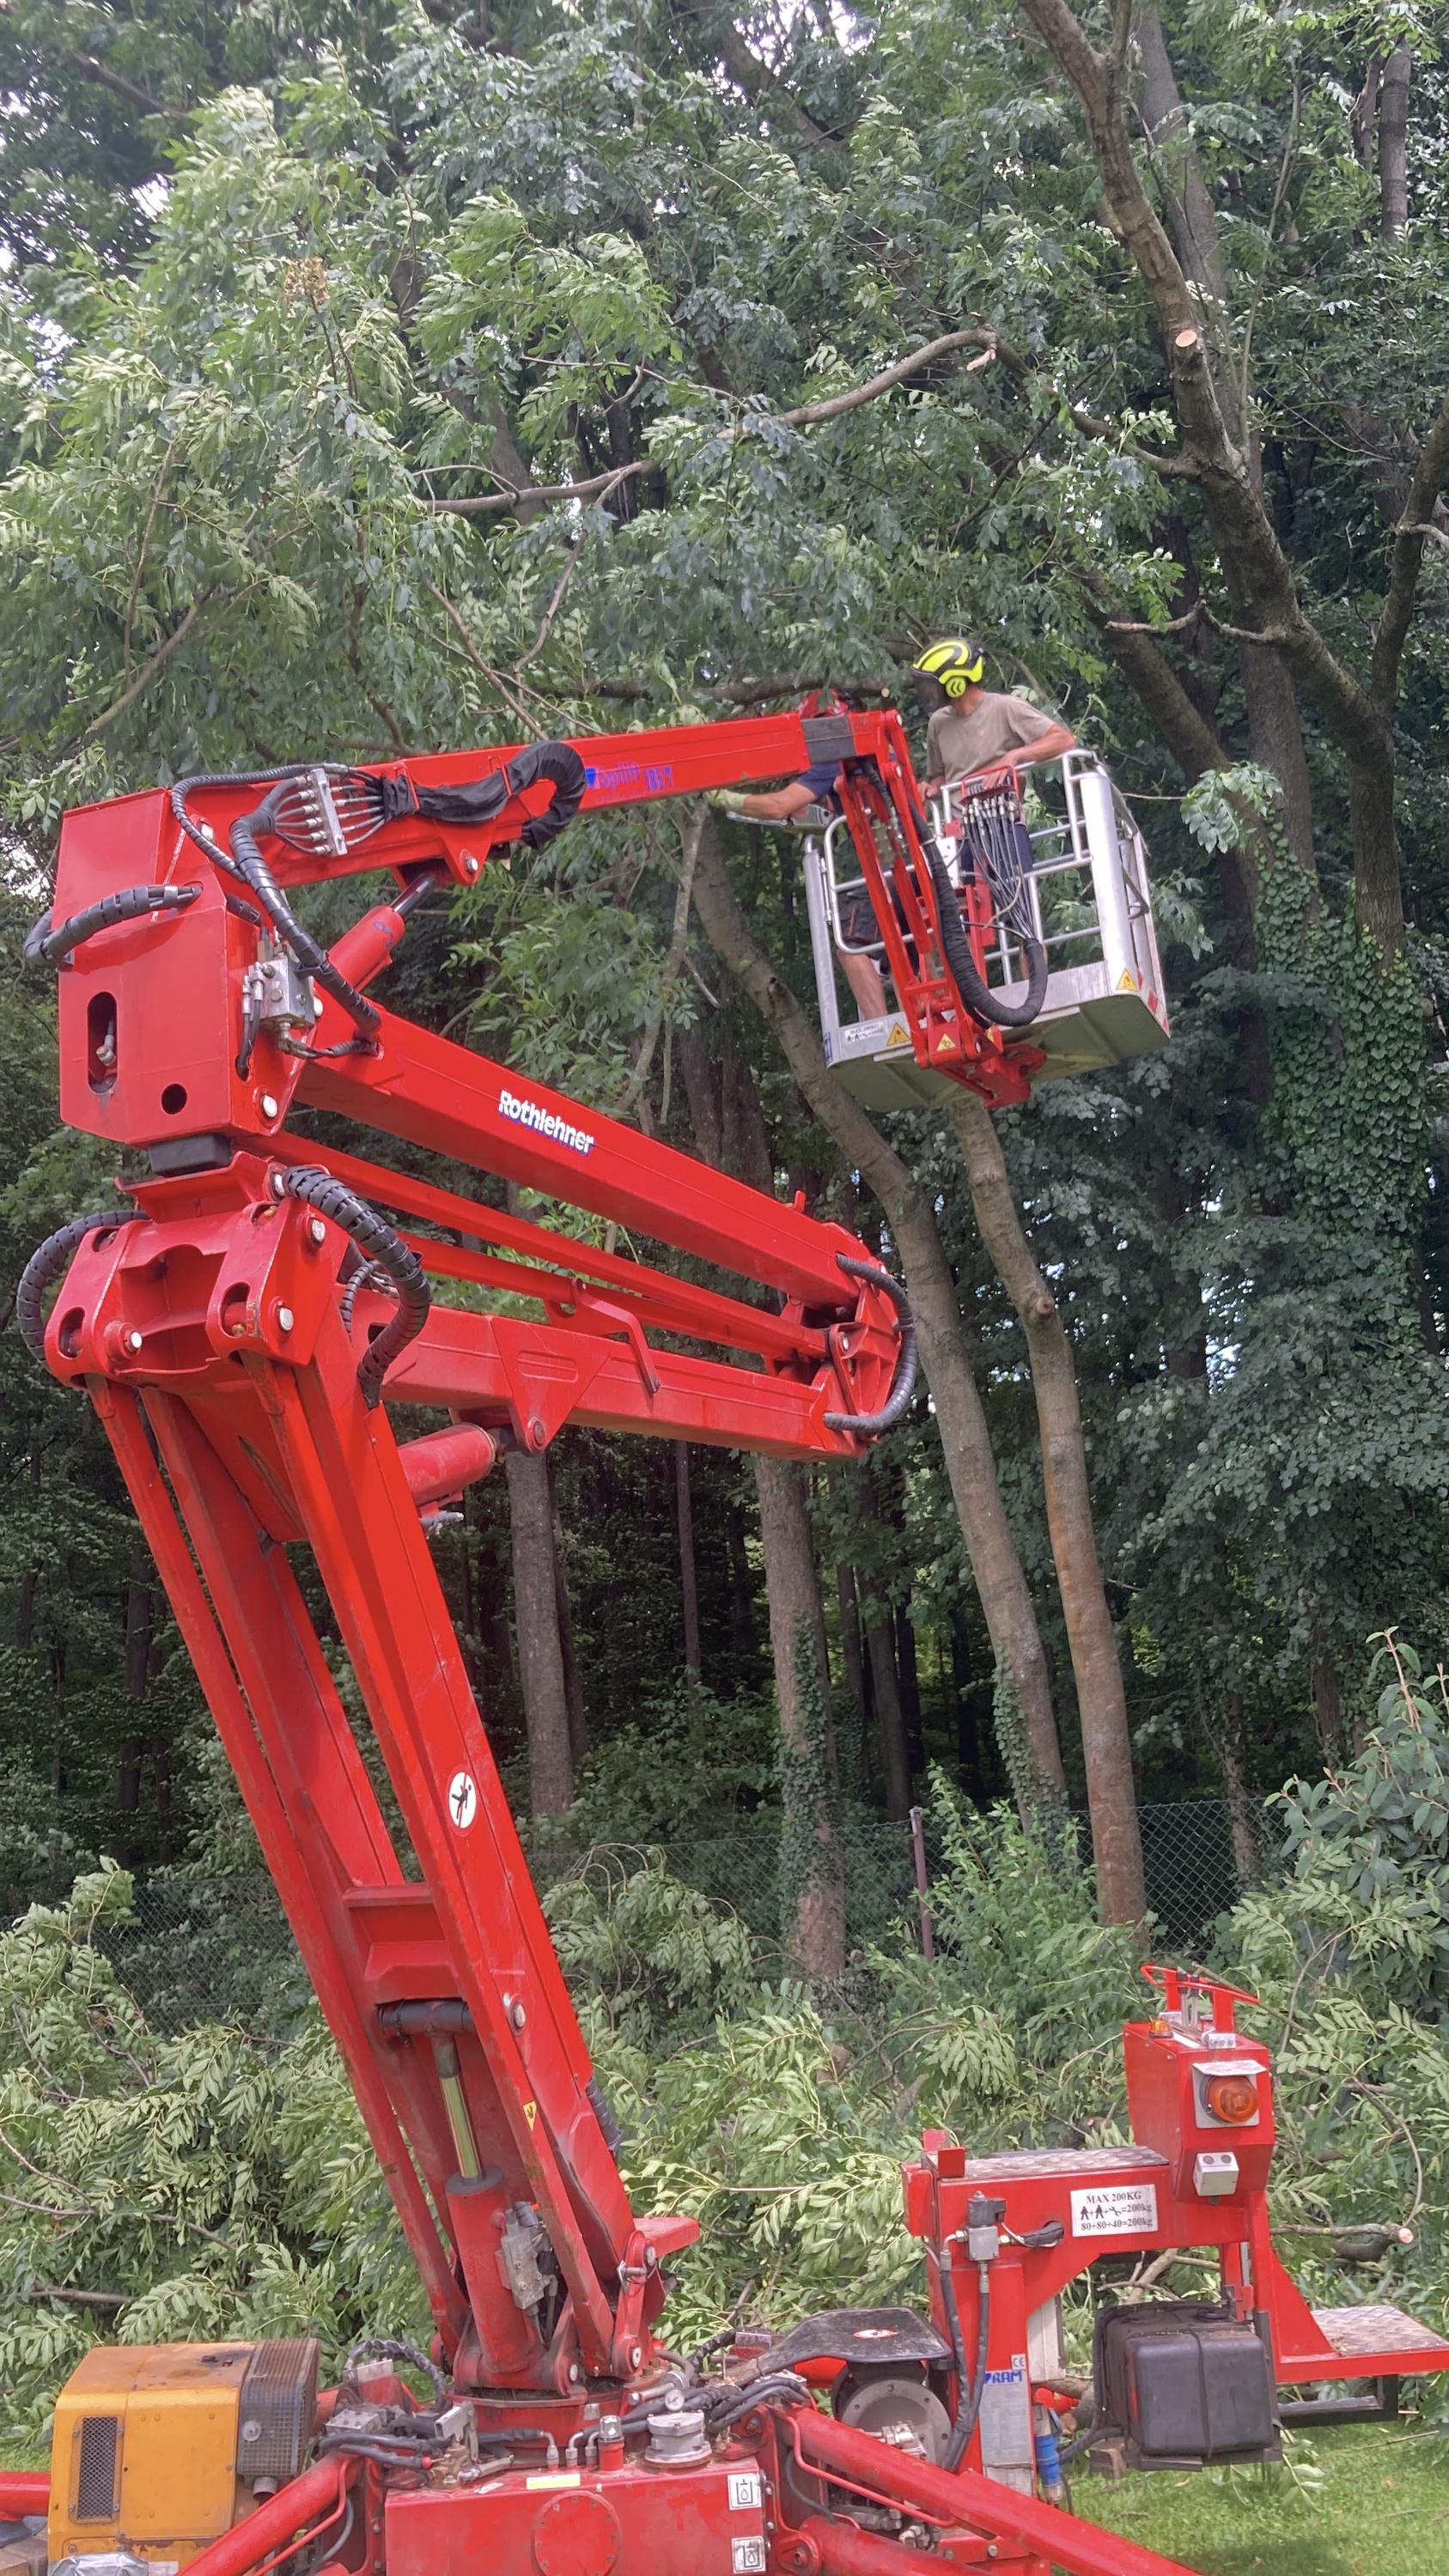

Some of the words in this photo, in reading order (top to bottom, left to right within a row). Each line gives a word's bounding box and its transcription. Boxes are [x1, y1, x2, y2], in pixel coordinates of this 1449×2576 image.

[498, 1089, 594, 1154] Rothlehner
[1087, 2194, 1109, 2204] MAX
[1111, 2190, 1142, 2202] 200KG
[1081, 2218, 1154, 2231] 80+80+40=200kg
[992, 2370, 1022, 2384] RAM
